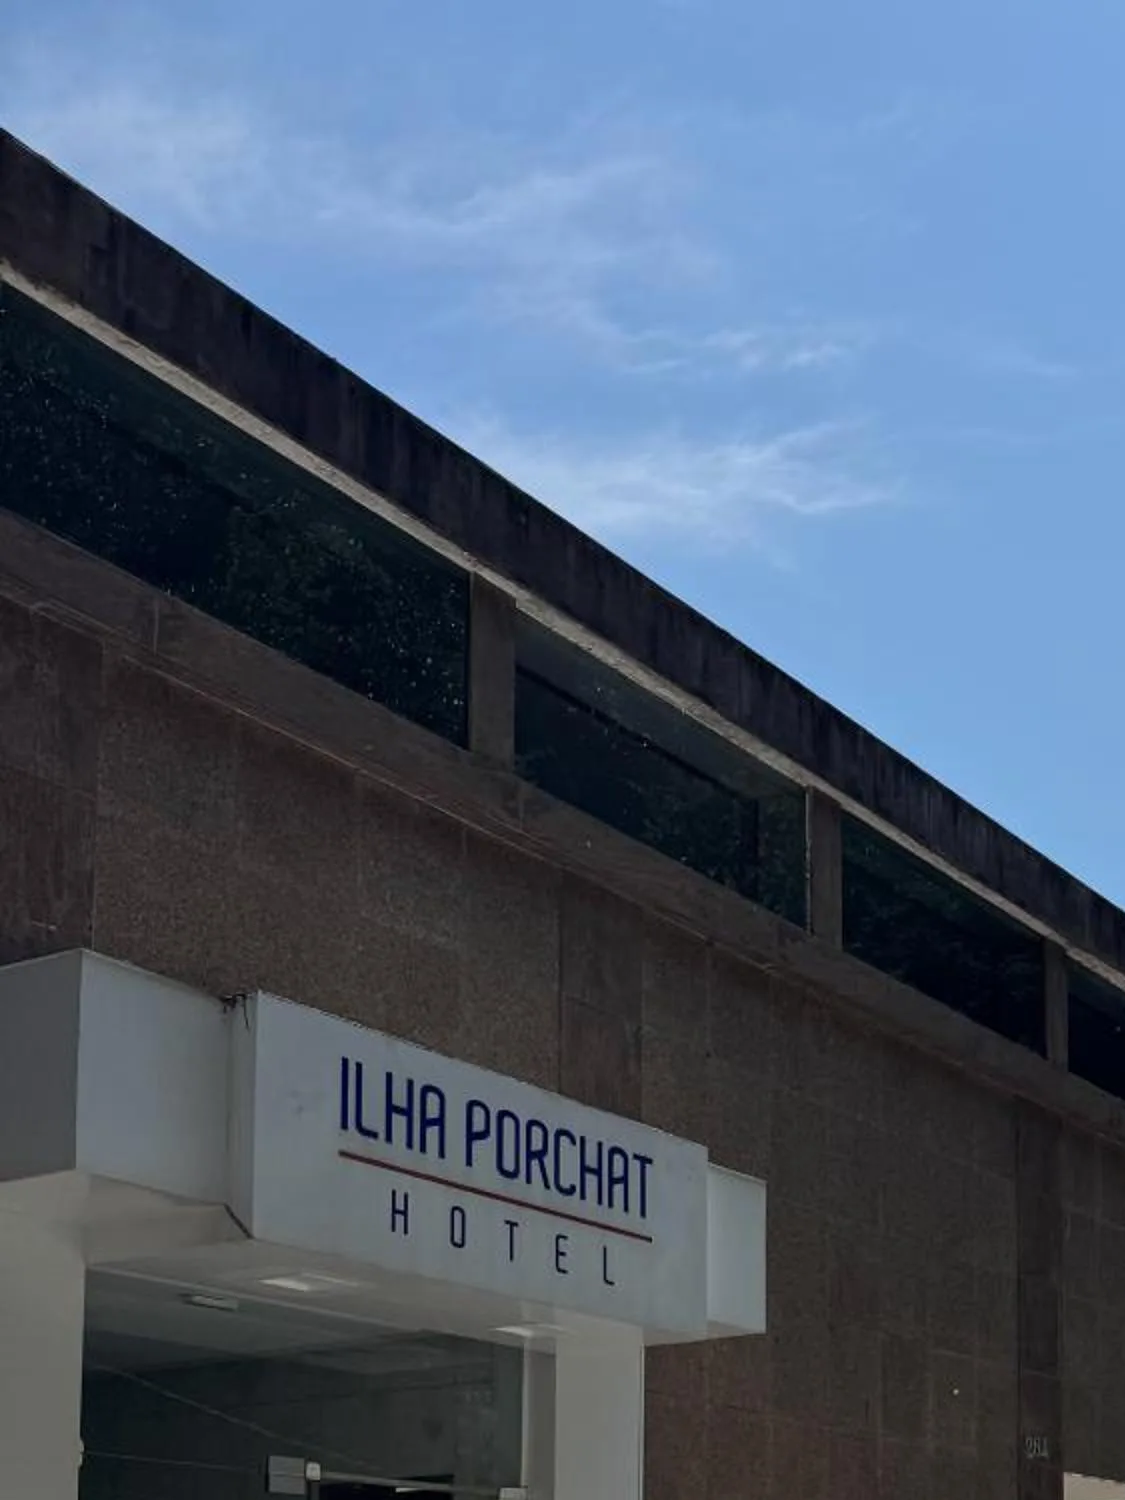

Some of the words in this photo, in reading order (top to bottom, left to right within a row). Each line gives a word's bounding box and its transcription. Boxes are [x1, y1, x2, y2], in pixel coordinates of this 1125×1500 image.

[340, 1056, 446, 1159] ILHA
[465, 1098, 654, 1219] PORCHAT
[391, 1189, 616, 1286] HOTEL
